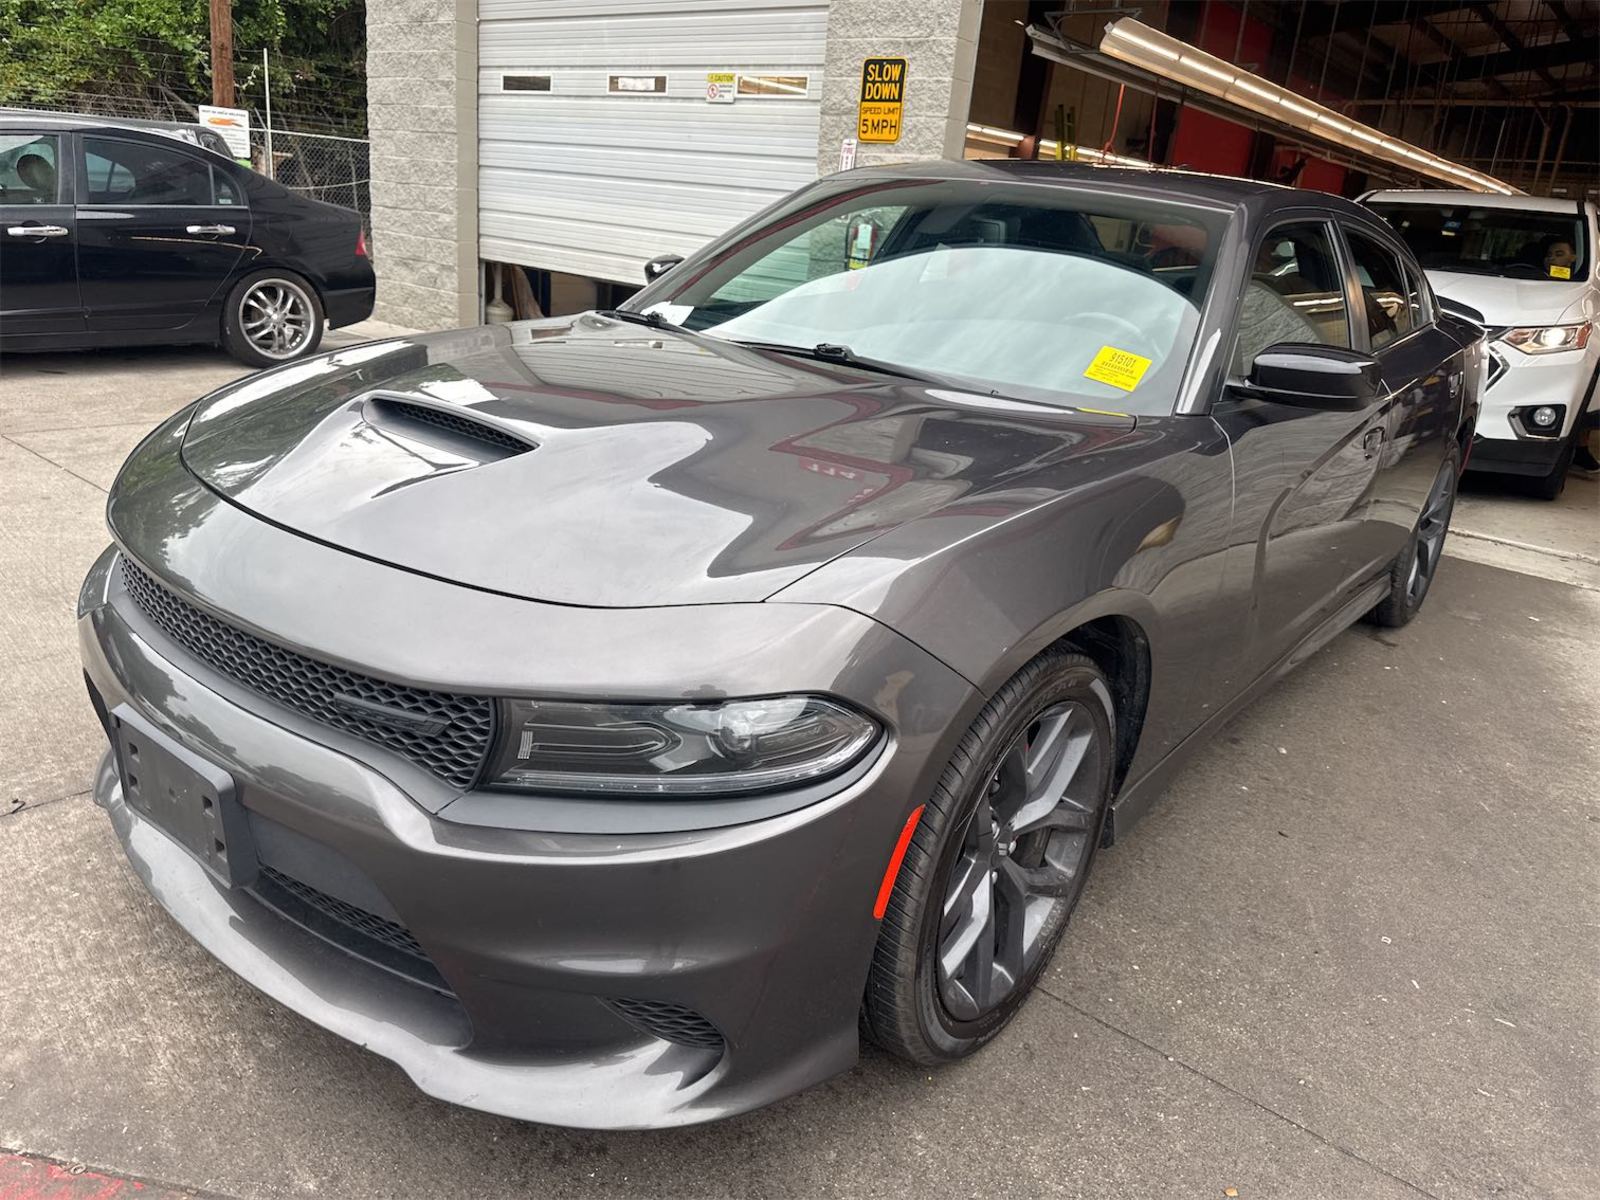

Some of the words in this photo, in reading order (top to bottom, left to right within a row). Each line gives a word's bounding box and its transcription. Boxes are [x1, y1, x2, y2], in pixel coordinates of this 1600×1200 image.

[867, 64, 902, 81] SLOW
[865, 83, 899, 99] DOWN
[861, 106, 881, 115] SPEED
[883, 107, 899, 115] LIMIT
[861, 118, 869, 134] 5
[871, 119, 897, 134] MPH
